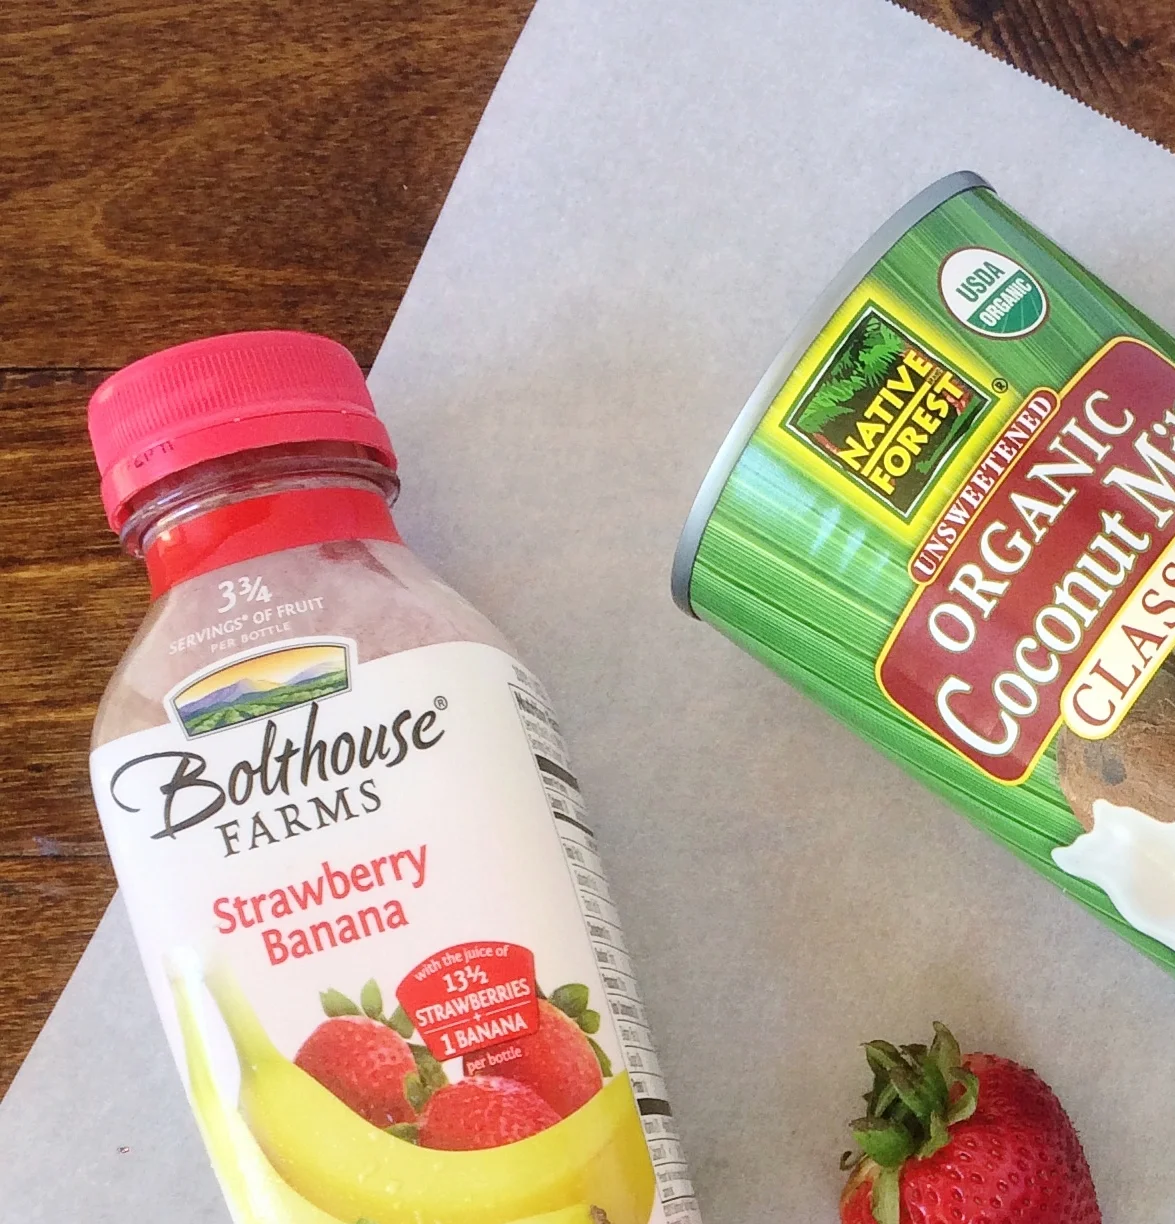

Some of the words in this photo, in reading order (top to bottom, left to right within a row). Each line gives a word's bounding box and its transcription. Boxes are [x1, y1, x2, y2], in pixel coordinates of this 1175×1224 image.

[955, 260, 1006, 304] USDA
[978, 276, 1034, 329] ORGANIC
[838, 348, 932, 472] NATIVE
[871, 371, 965, 497] FOREST
[913, 395, 1053, 578] UNSWEETENED
[928, 389, 1136, 654] ORGANIC
[210, 638, 236, 653] PER
[241, 621, 291, 643] BOTTLE
[252, 608, 273, 624] OF
[276, 597, 324, 618] FRUIT
[935, 509, 1151, 757] Coconut
[110, 701, 445, 840] Bolthouse
[214, 778, 382, 858] FARMS
[213, 844, 428, 935] Strawberry
[260, 900, 409, 967] Banana
[413, 960, 442, 981] with
[443, 951, 463, 966] the
[464, 946, 494, 963] juice
[495, 944, 510, 958] of
[415, 978, 531, 1028] STRAWBERRIES
[440, 1033, 457, 1056] 1
[454, 1012, 529, 1049] BANANA
[466, 1059, 486, 1075] per
[487, 1046, 523, 1067] bottle
